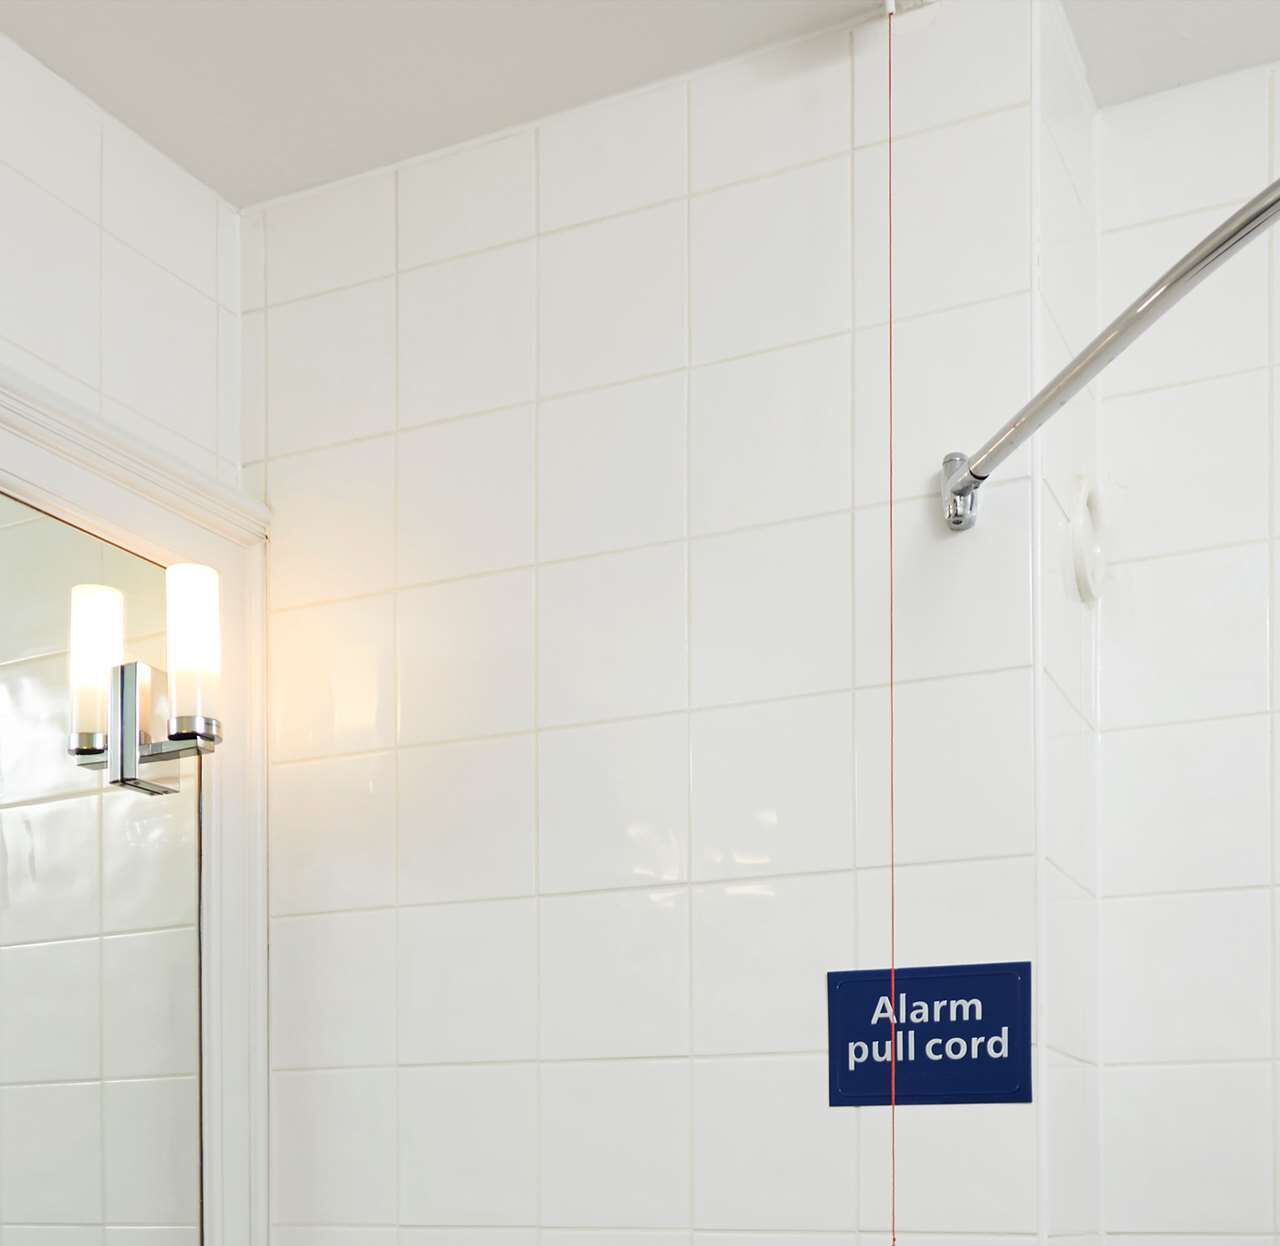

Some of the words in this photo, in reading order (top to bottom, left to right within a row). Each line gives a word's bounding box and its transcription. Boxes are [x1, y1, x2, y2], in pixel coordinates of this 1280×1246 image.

[871, 993, 982, 1025] Alarm
[848, 1030, 915, 1071] pull
[925, 1026, 1009, 1060] cord
